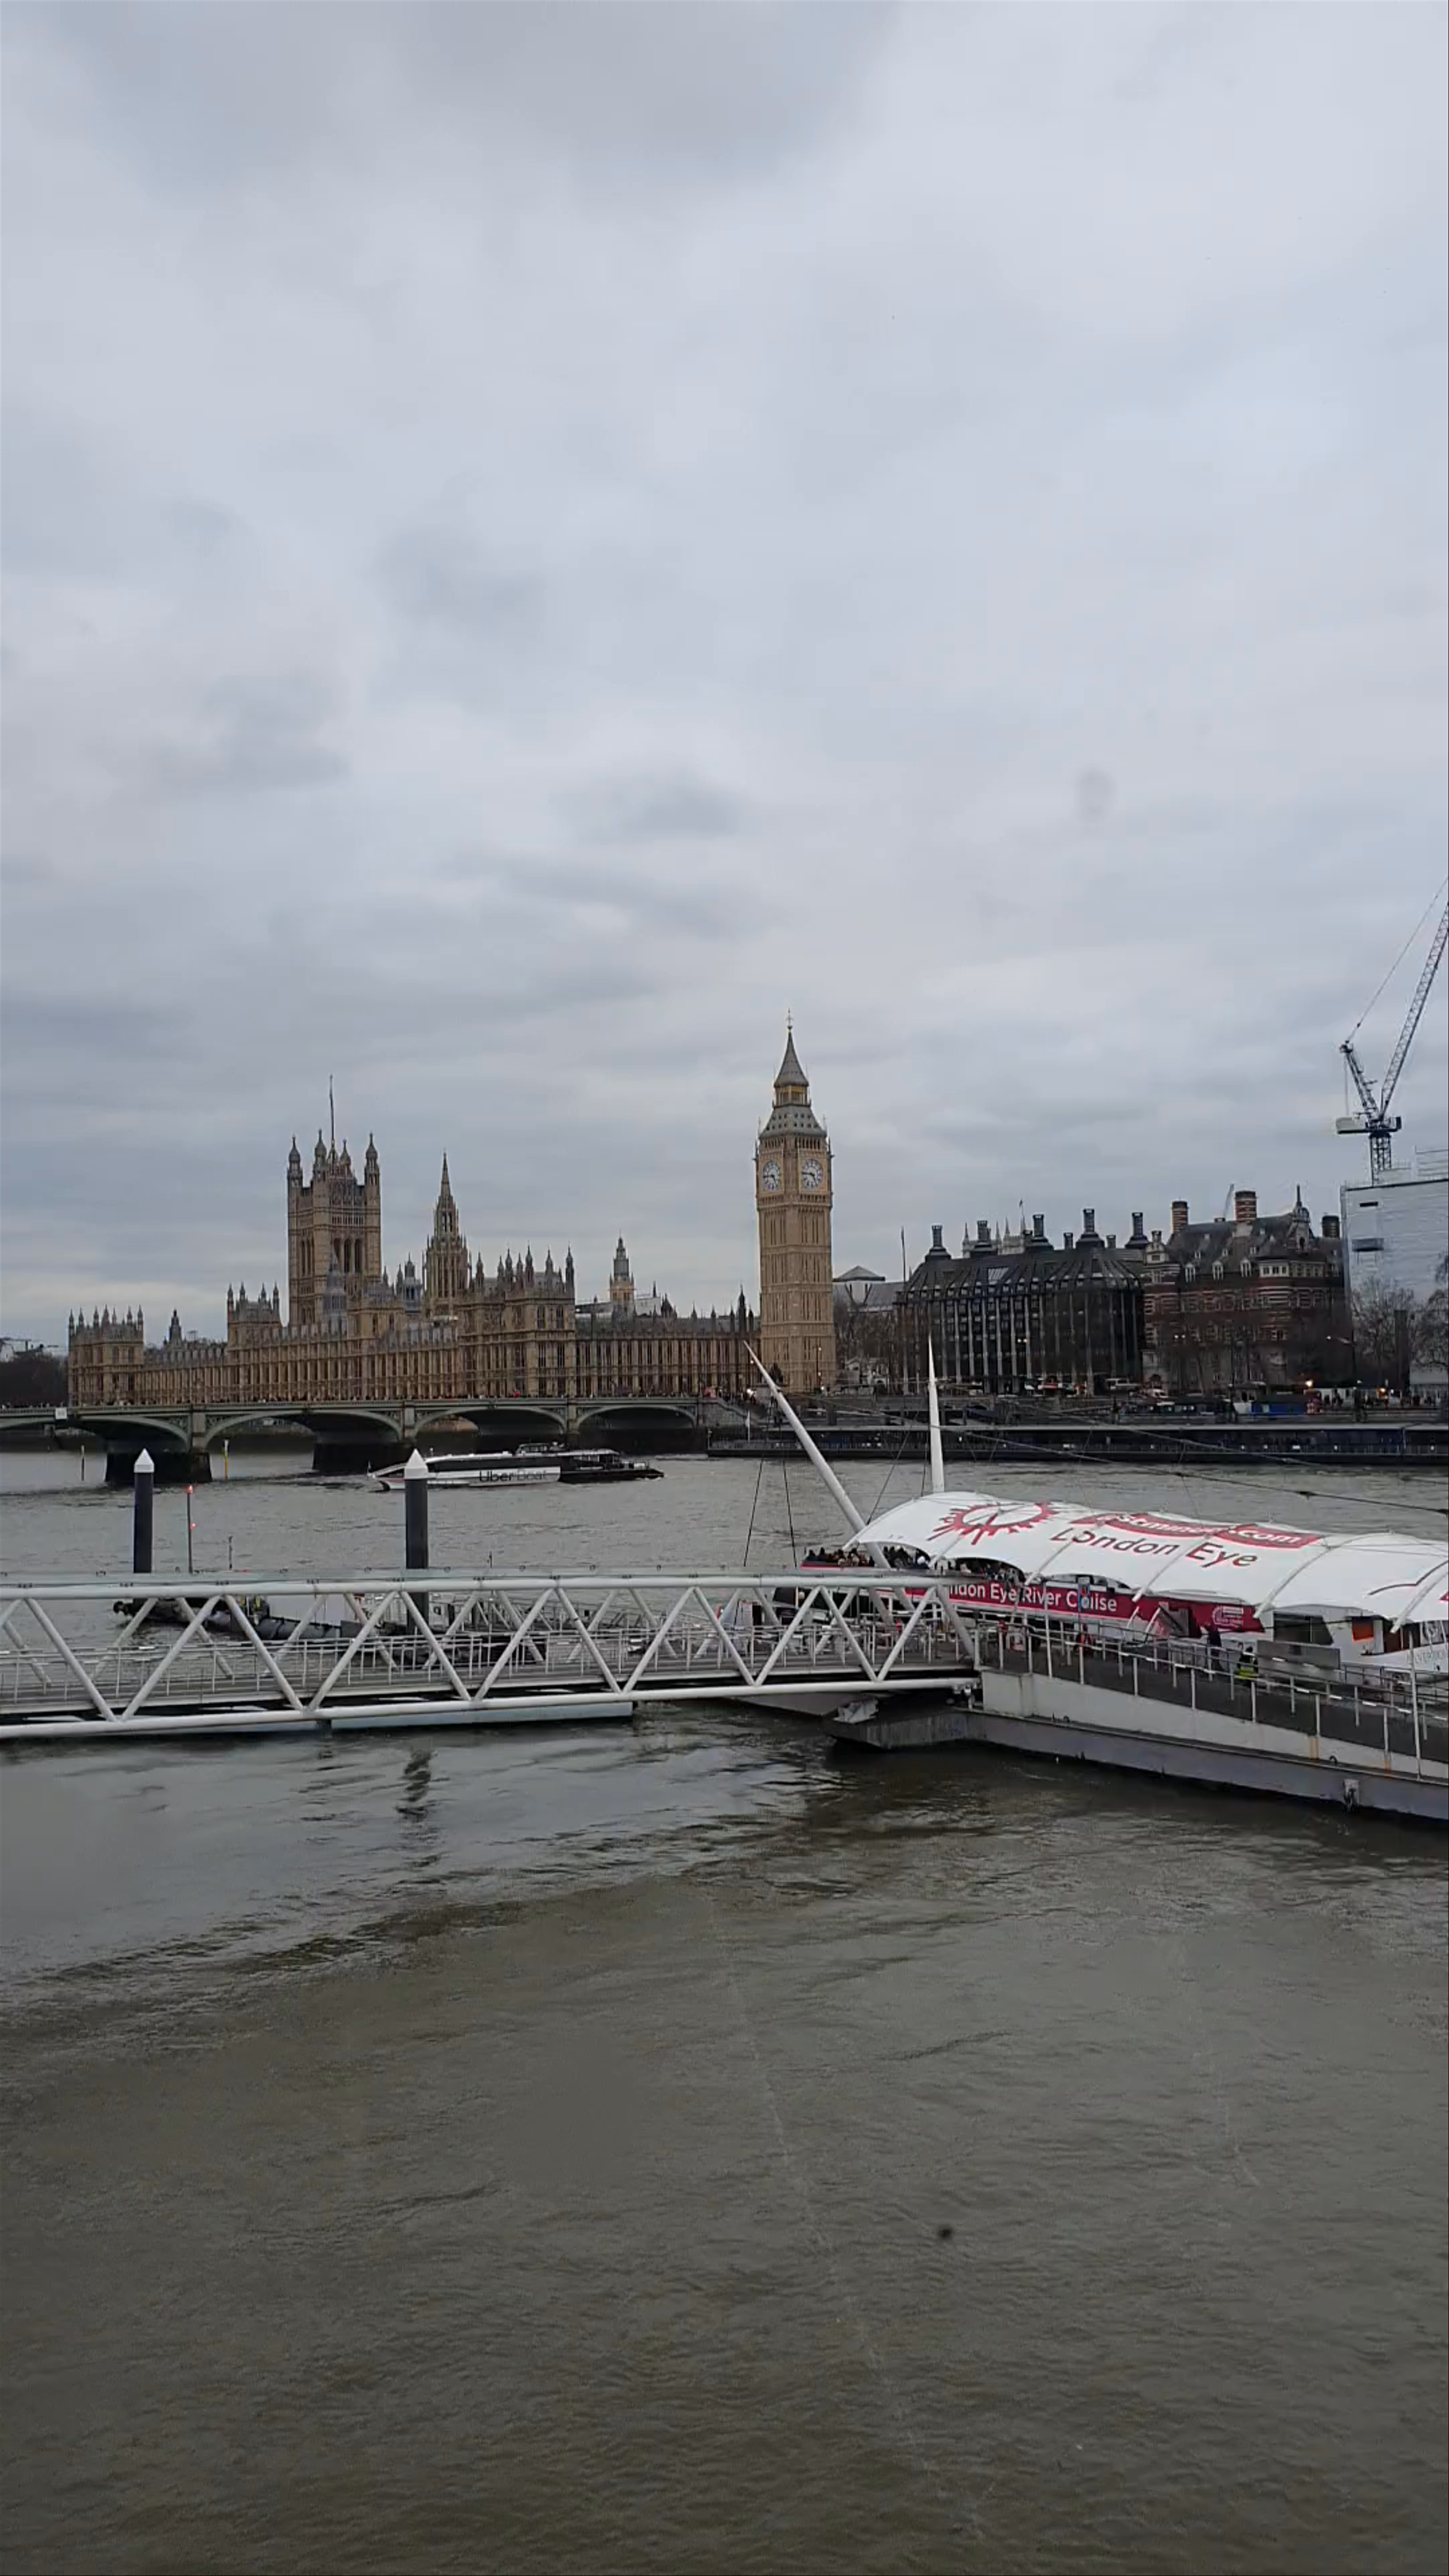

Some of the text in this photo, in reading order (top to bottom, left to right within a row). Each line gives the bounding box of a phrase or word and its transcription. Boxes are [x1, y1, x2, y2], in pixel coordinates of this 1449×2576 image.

[480, 1469, 547, 1482] Uber Boat
[1049, 1527, 1258, 1568] London Eye
[950, 1583, 1117, 1612] ndon Eye River Cise
